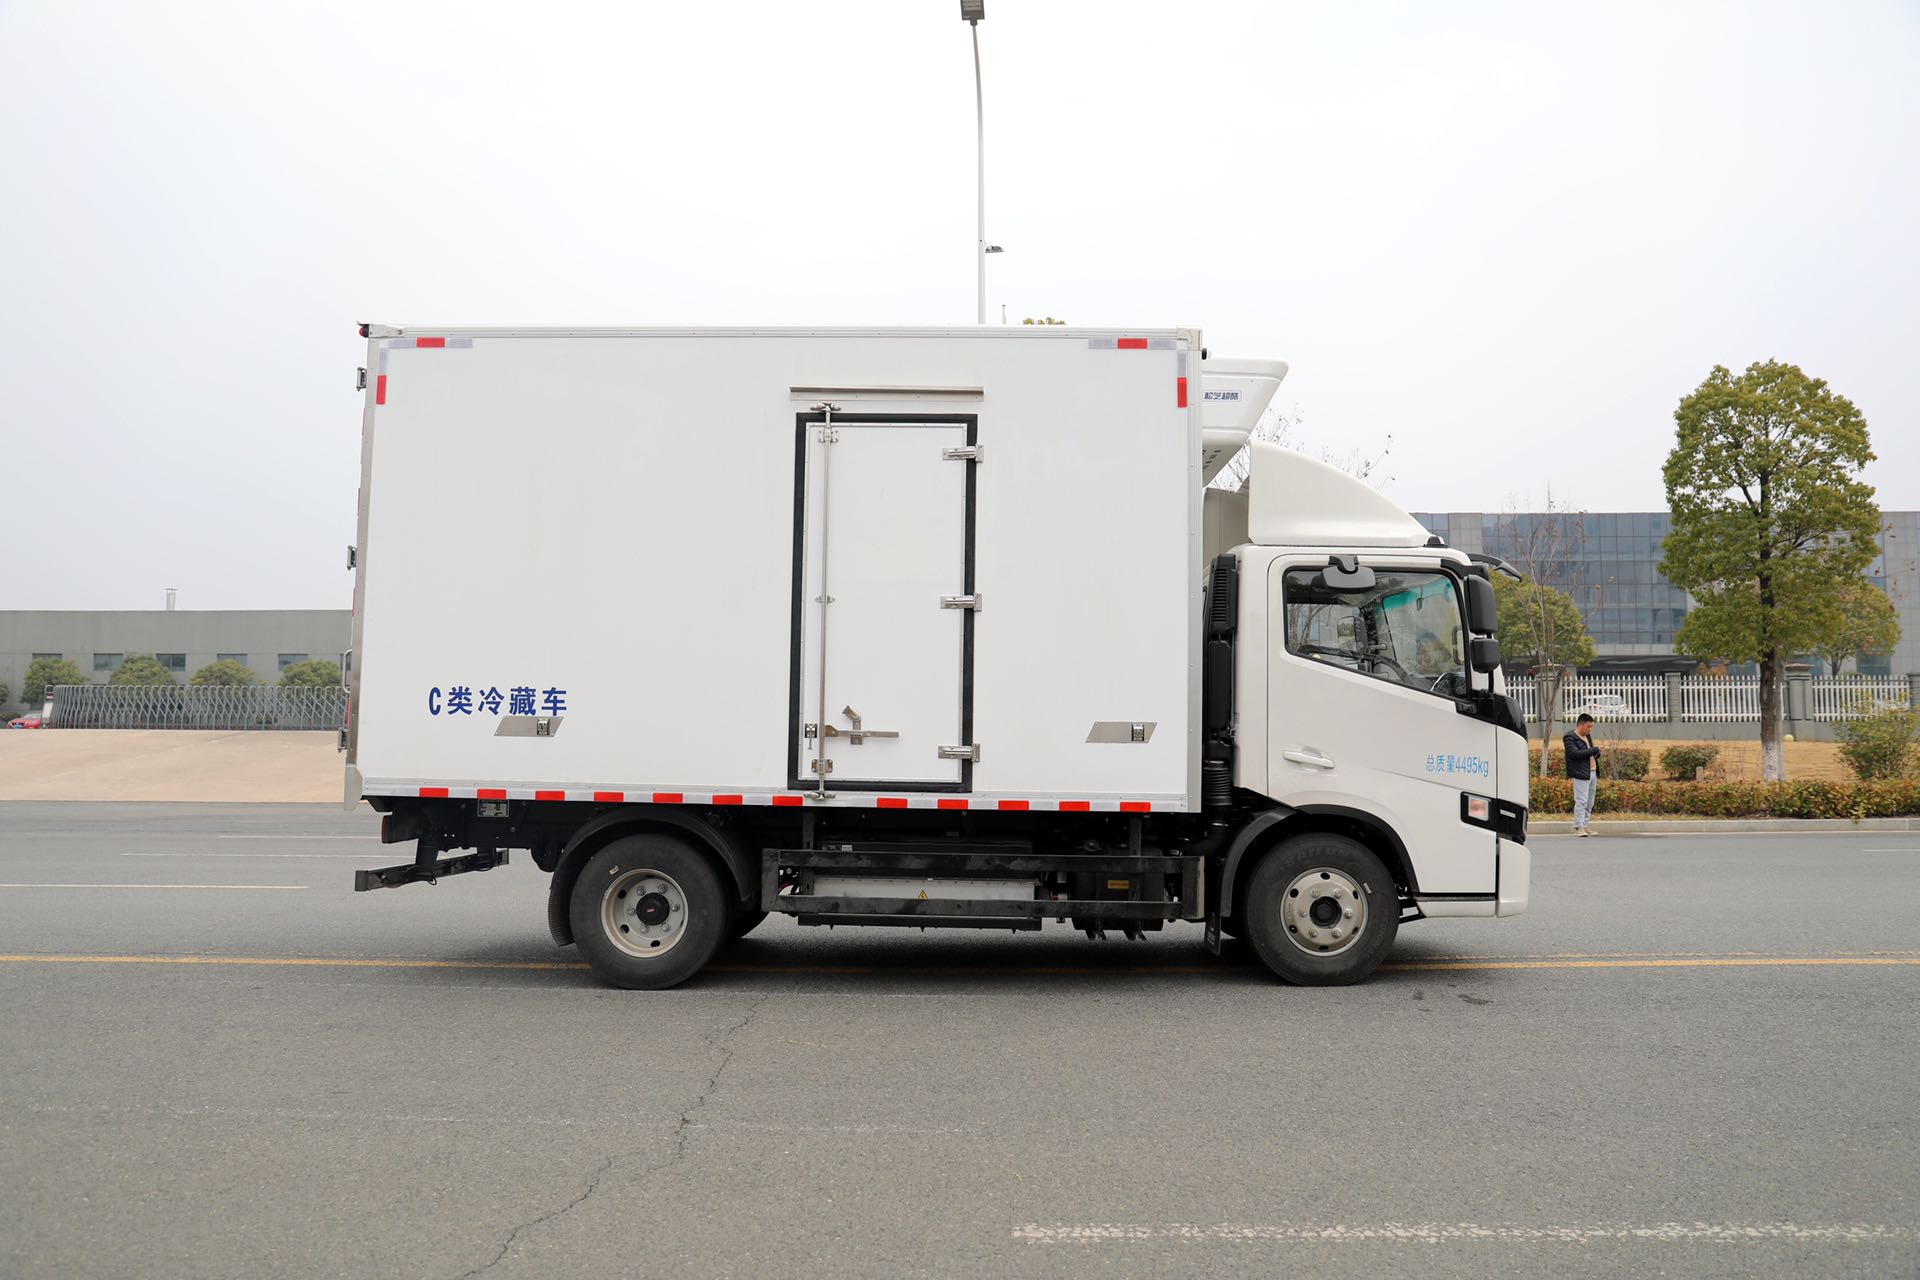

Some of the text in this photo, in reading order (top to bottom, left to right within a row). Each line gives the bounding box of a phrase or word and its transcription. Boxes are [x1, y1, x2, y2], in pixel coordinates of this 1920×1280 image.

[428, 686, 567, 717] C类冷藏车
[1425, 754, 1489, 778] 总质量4495kg
